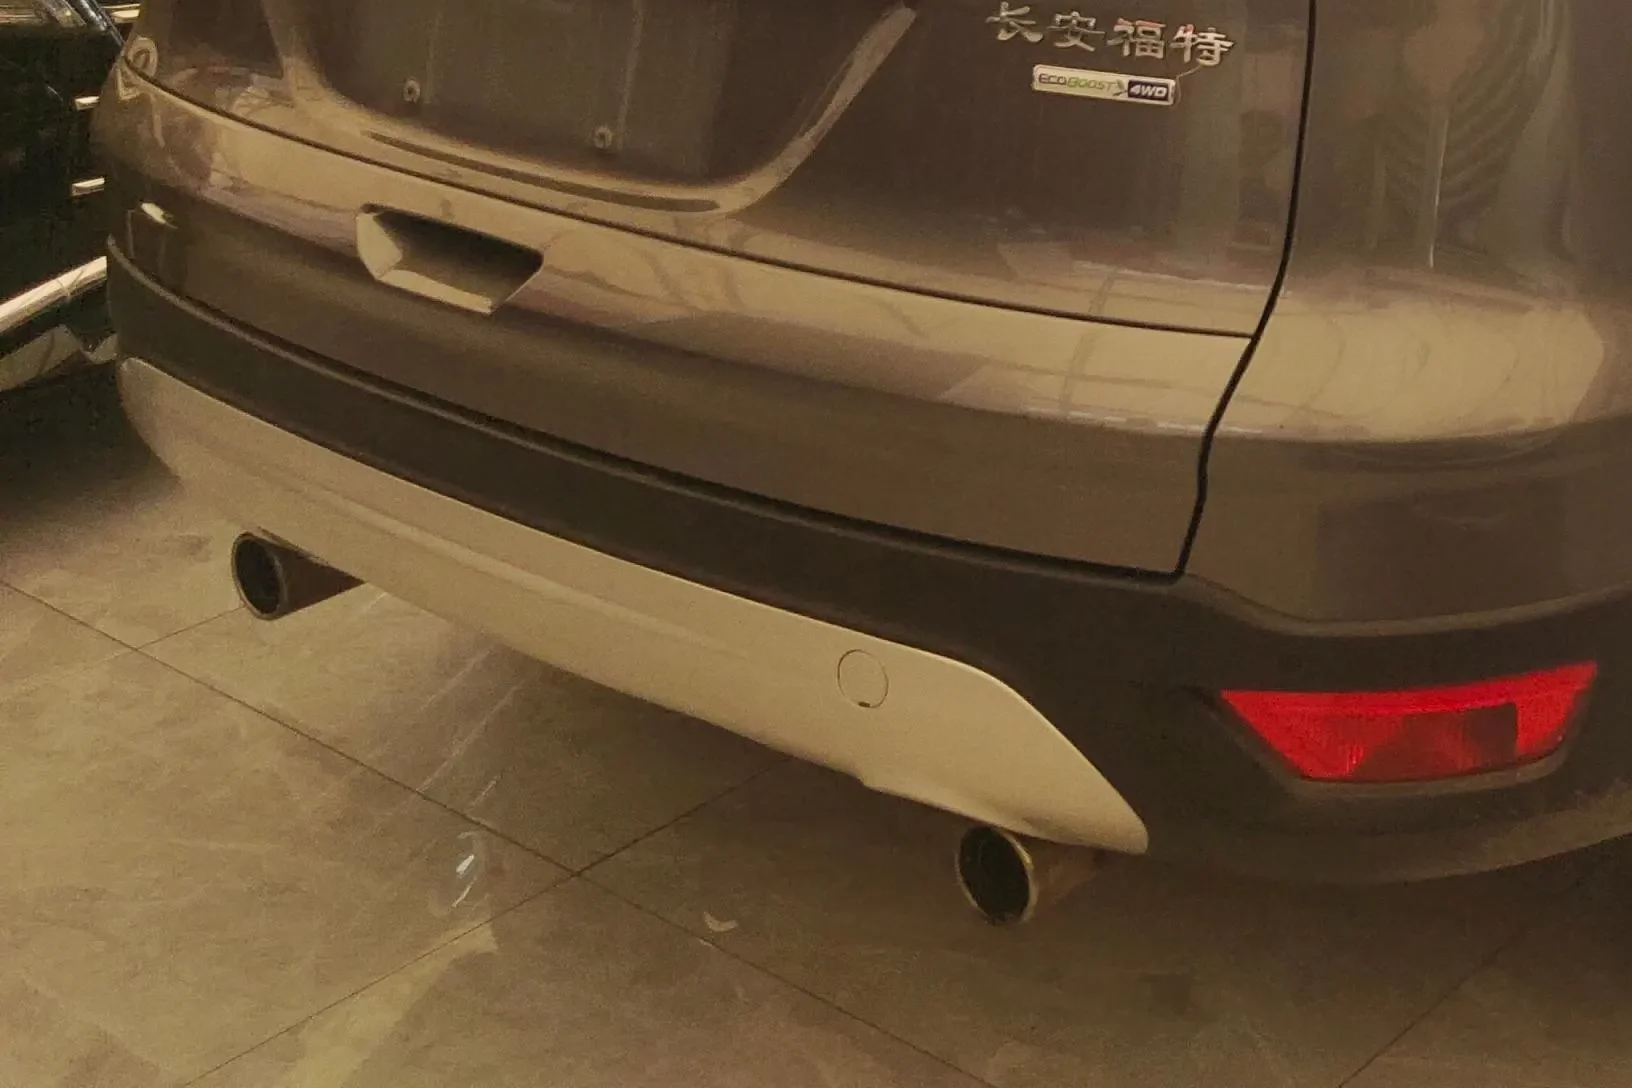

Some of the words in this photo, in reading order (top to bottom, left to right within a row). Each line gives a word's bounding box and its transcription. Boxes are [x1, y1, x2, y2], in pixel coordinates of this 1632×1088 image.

[985, 1, 1236, 66] 长安福特
[1129, 84, 1168, 98] 4WD
